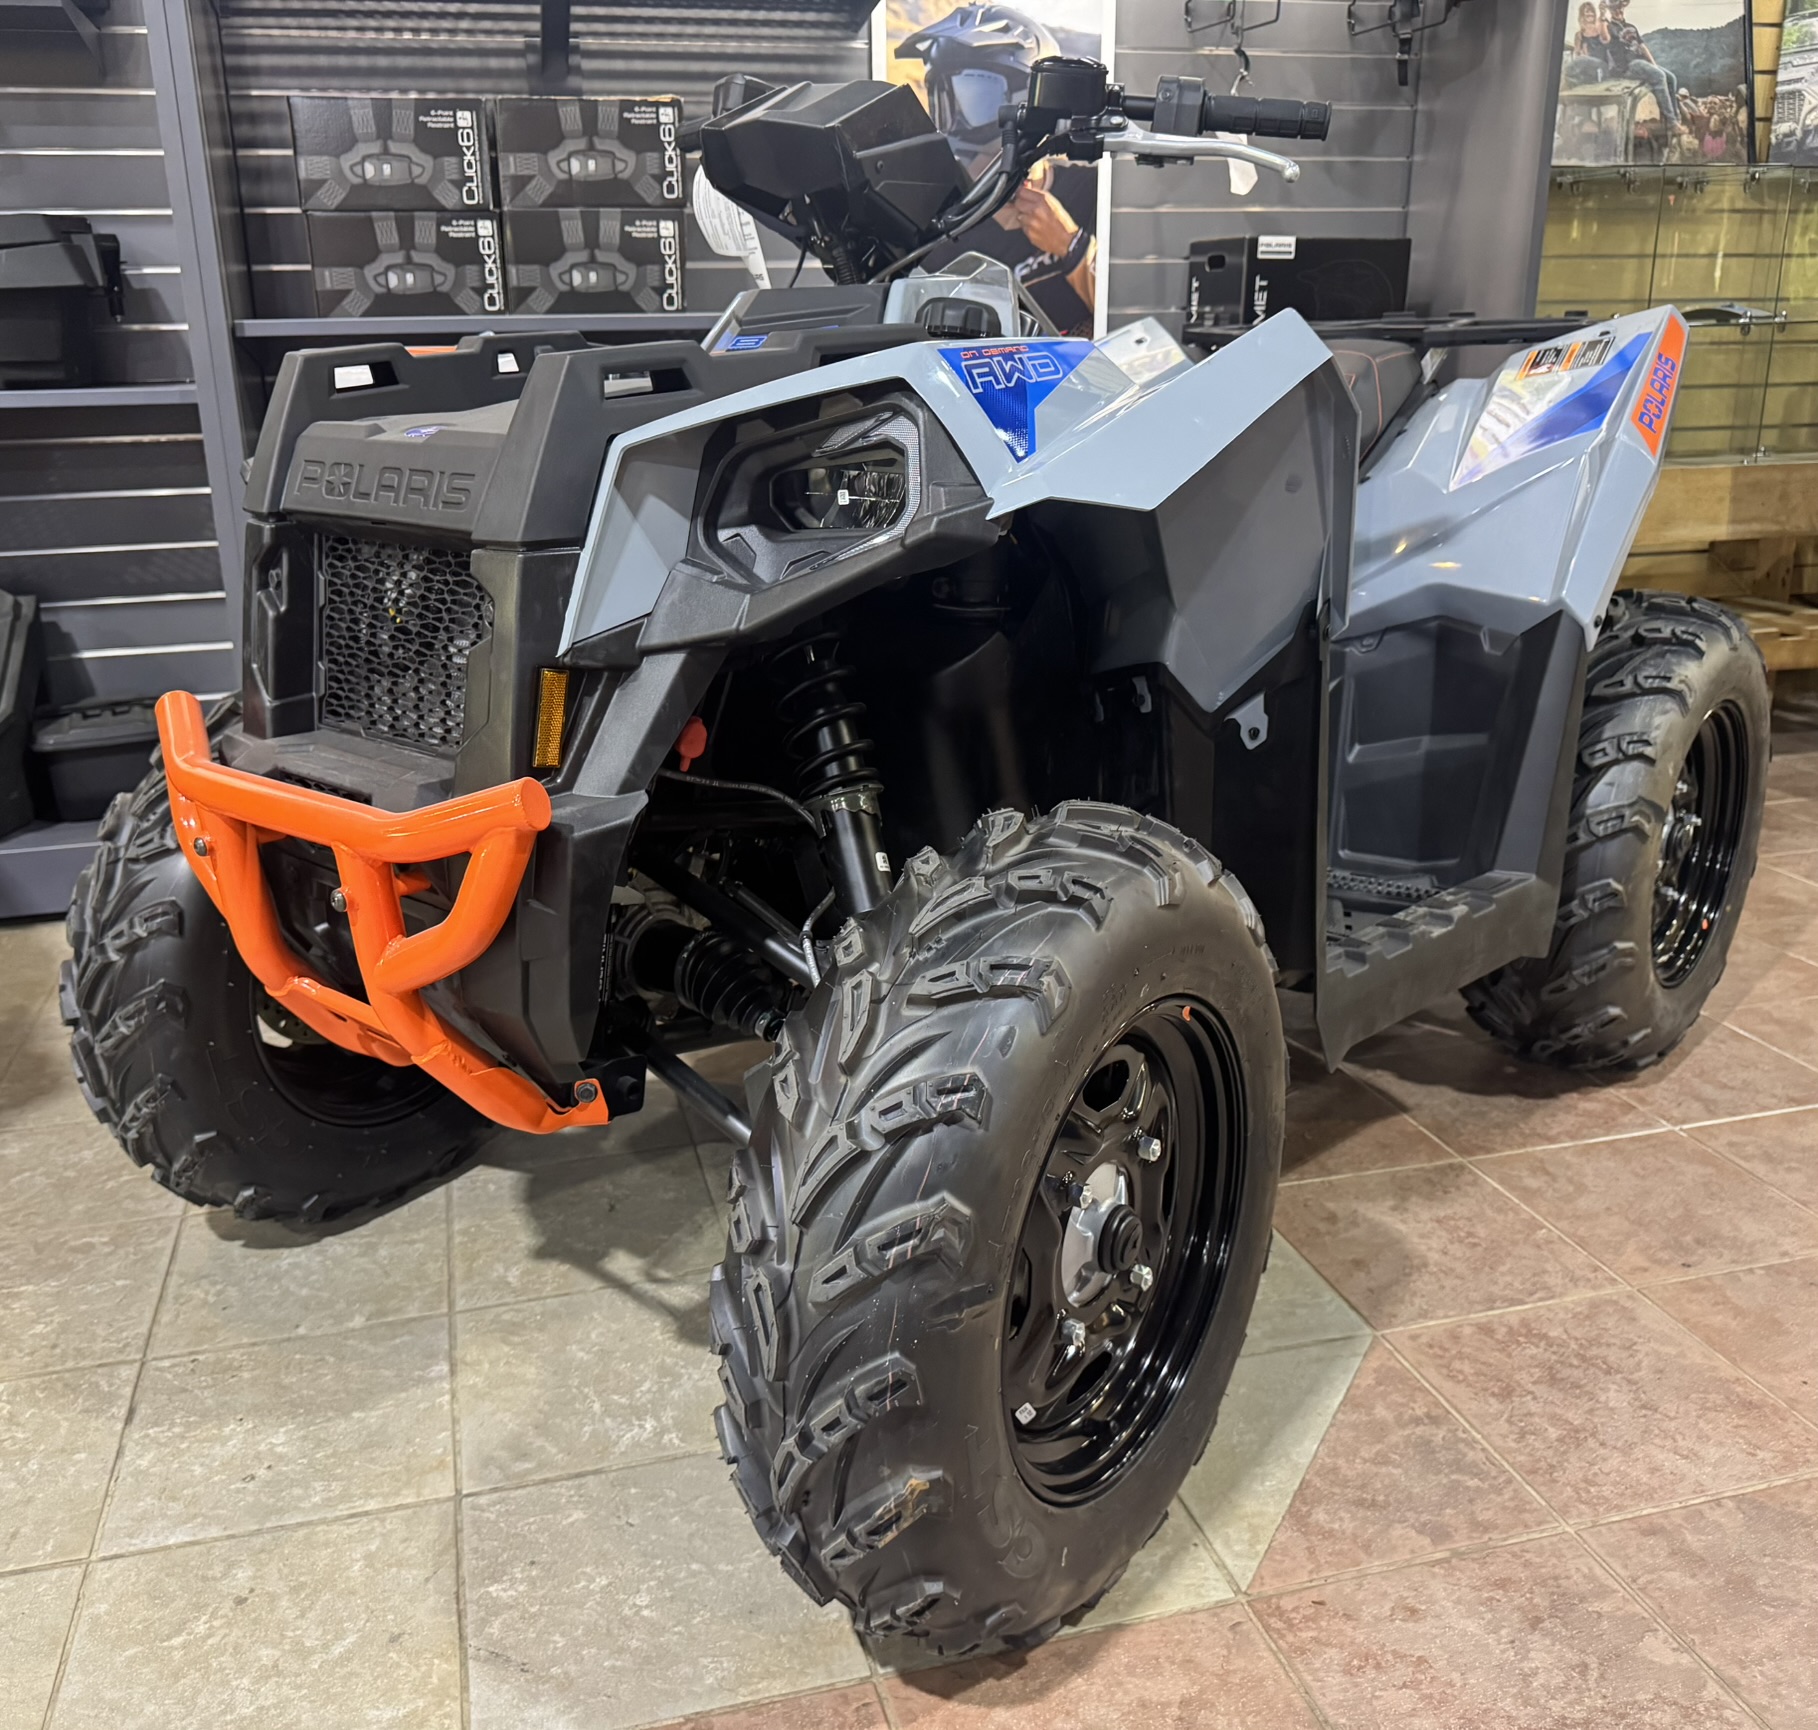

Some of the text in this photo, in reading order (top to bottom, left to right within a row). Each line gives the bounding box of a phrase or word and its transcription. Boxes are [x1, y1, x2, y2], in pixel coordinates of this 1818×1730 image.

[960, 345, 1029, 359] ON DEMAND
[961, 351, 1064, 394] AWD
[1638, 352, 1677, 434] POLARIS
[294, 459, 476, 513] POLARIS
